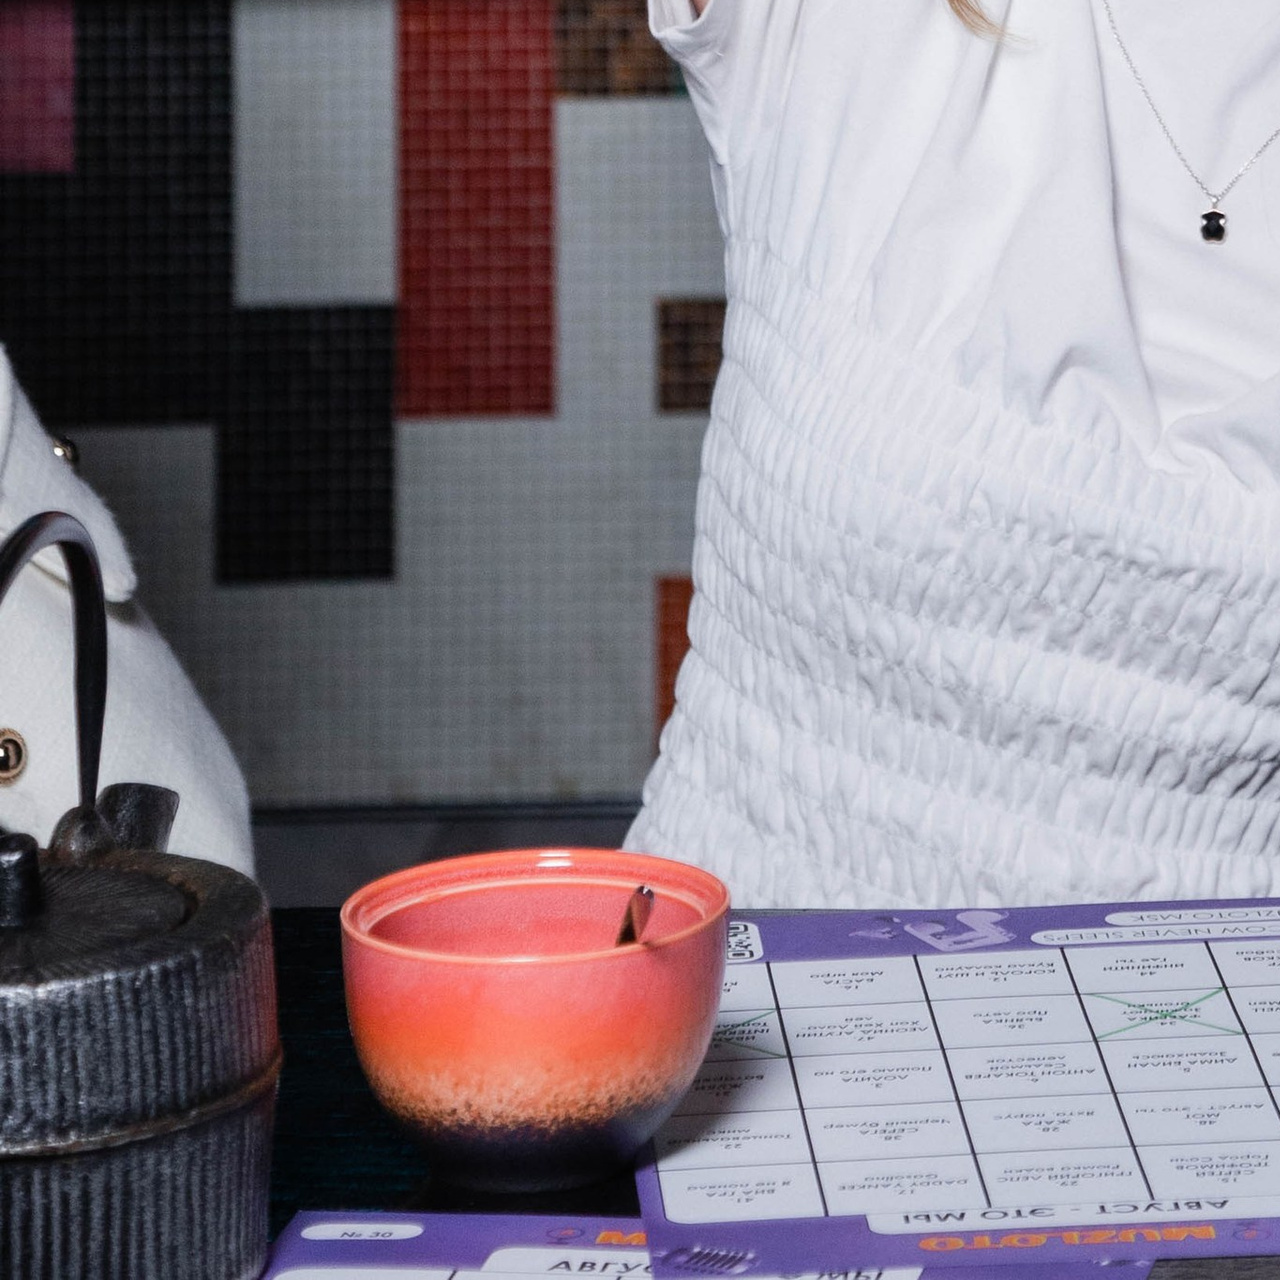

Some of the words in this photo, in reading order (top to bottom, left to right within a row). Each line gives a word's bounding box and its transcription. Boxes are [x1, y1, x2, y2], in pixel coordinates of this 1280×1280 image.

[1041, 930, 1124, 942] SLEEPS
[1130, 927, 1212, 938] NEVER
[1091, 1198, 1232, 1215] АВГУСТ
[901, 1211, 968, 1224] МЫ
[978, 1207, 1056, 1220] ЭТО
[915, 1223, 1218, 1252] MUZLOTO
